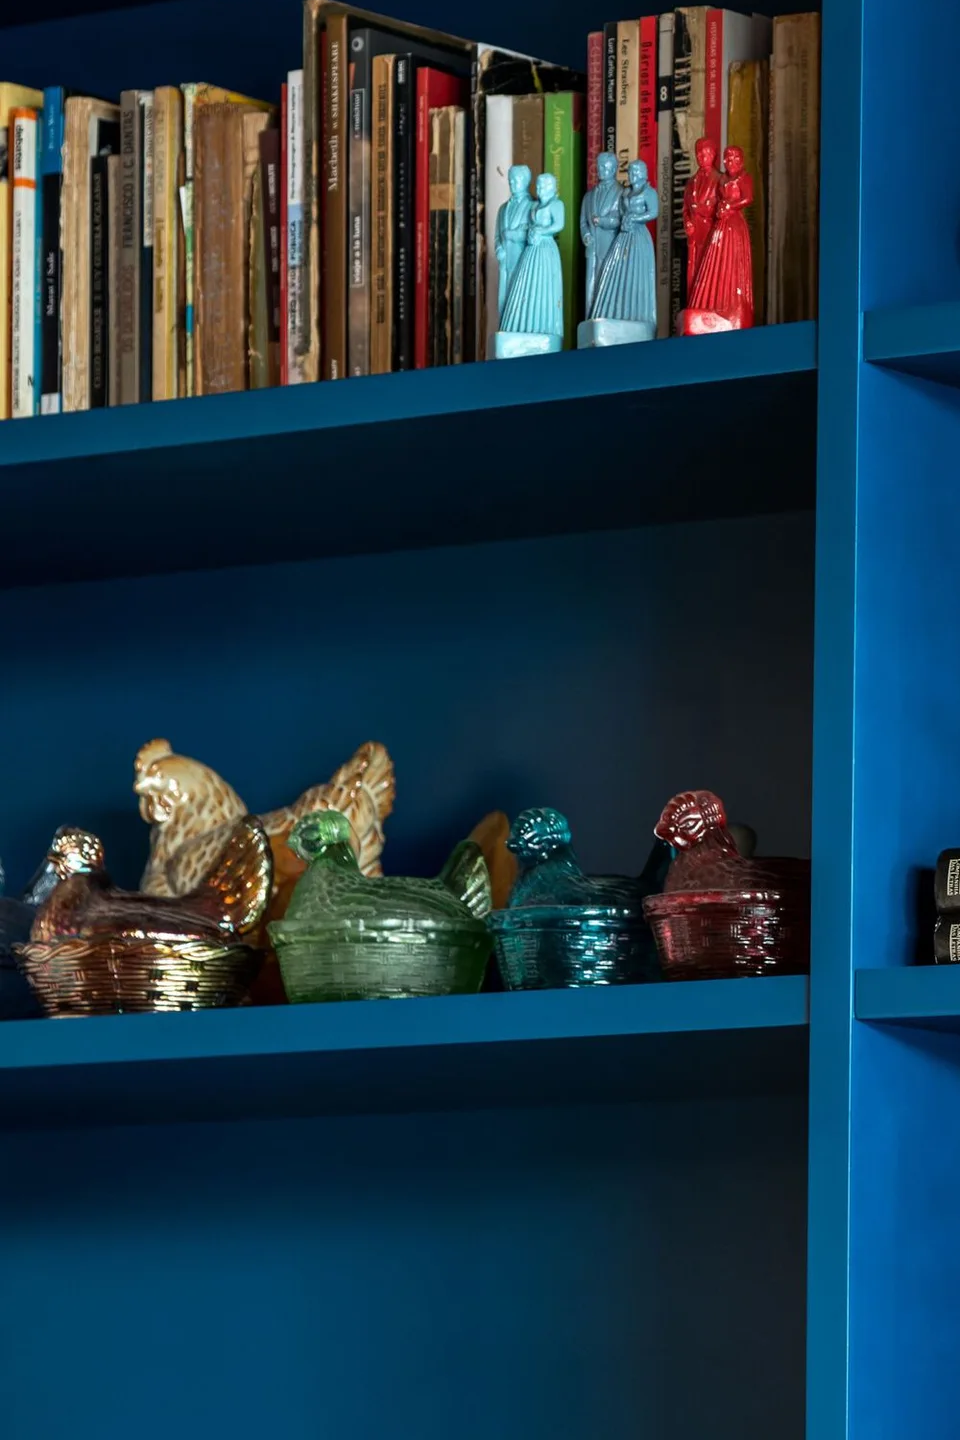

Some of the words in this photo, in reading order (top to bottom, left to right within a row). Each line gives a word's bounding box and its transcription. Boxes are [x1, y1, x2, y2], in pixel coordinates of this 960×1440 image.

[606, 55, 615, 78] Carlos
[622, 38, 631, 55] Lee
[330, 41, 339, 117] SHAKESPEARE
[619, 58, 631, 106] Strasberg
[640, 90, 652, 103] de
[659, 85, 668, 102] 8
[16, 124, 24, 170] debates
[123, 110, 135, 155] DANTAS
[327, 135, 339, 192] Macbeth
[660, 156, 670, 203] Completo
[354, 239, 361, 250] la
